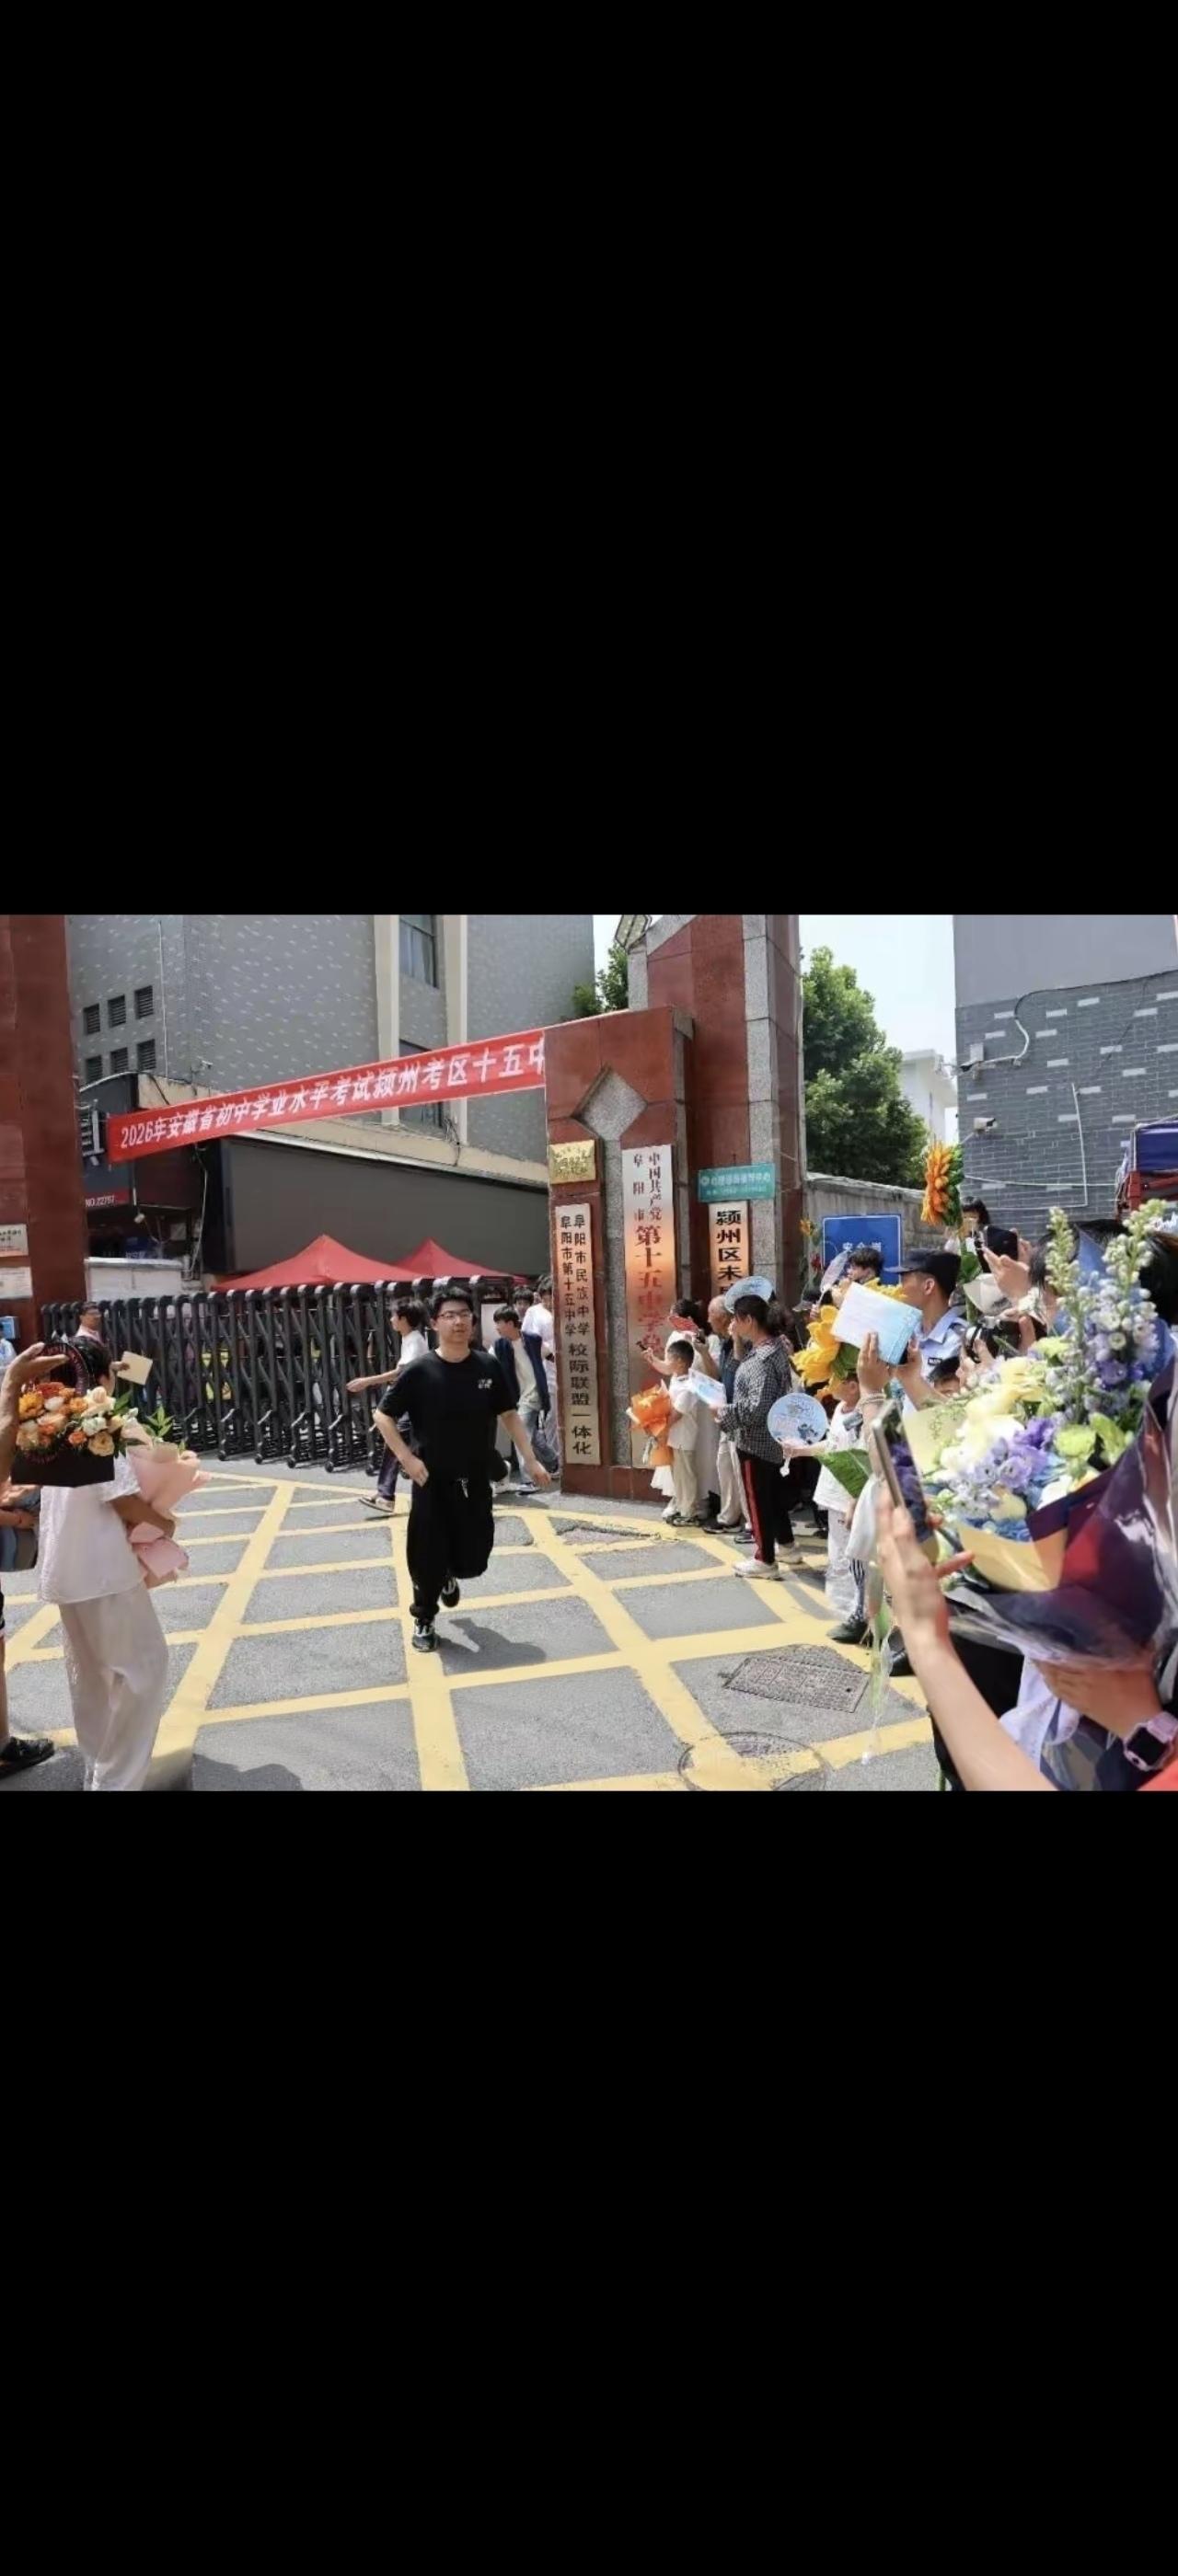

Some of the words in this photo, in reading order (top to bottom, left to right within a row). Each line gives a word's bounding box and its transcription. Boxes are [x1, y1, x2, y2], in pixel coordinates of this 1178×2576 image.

[632, 1154, 644, 1222] 阜阳市
[649, 1153, 662, 1221] 中国共产党
[560, 1215, 576, 1336] 阜阳市第十五中学
[574, 1214, 590, 1335] 阜阳市民族中学
[716, 1210, 742, 1294] 颍州区未
[568, 1343, 592, 1455] 校际联盟一体化
